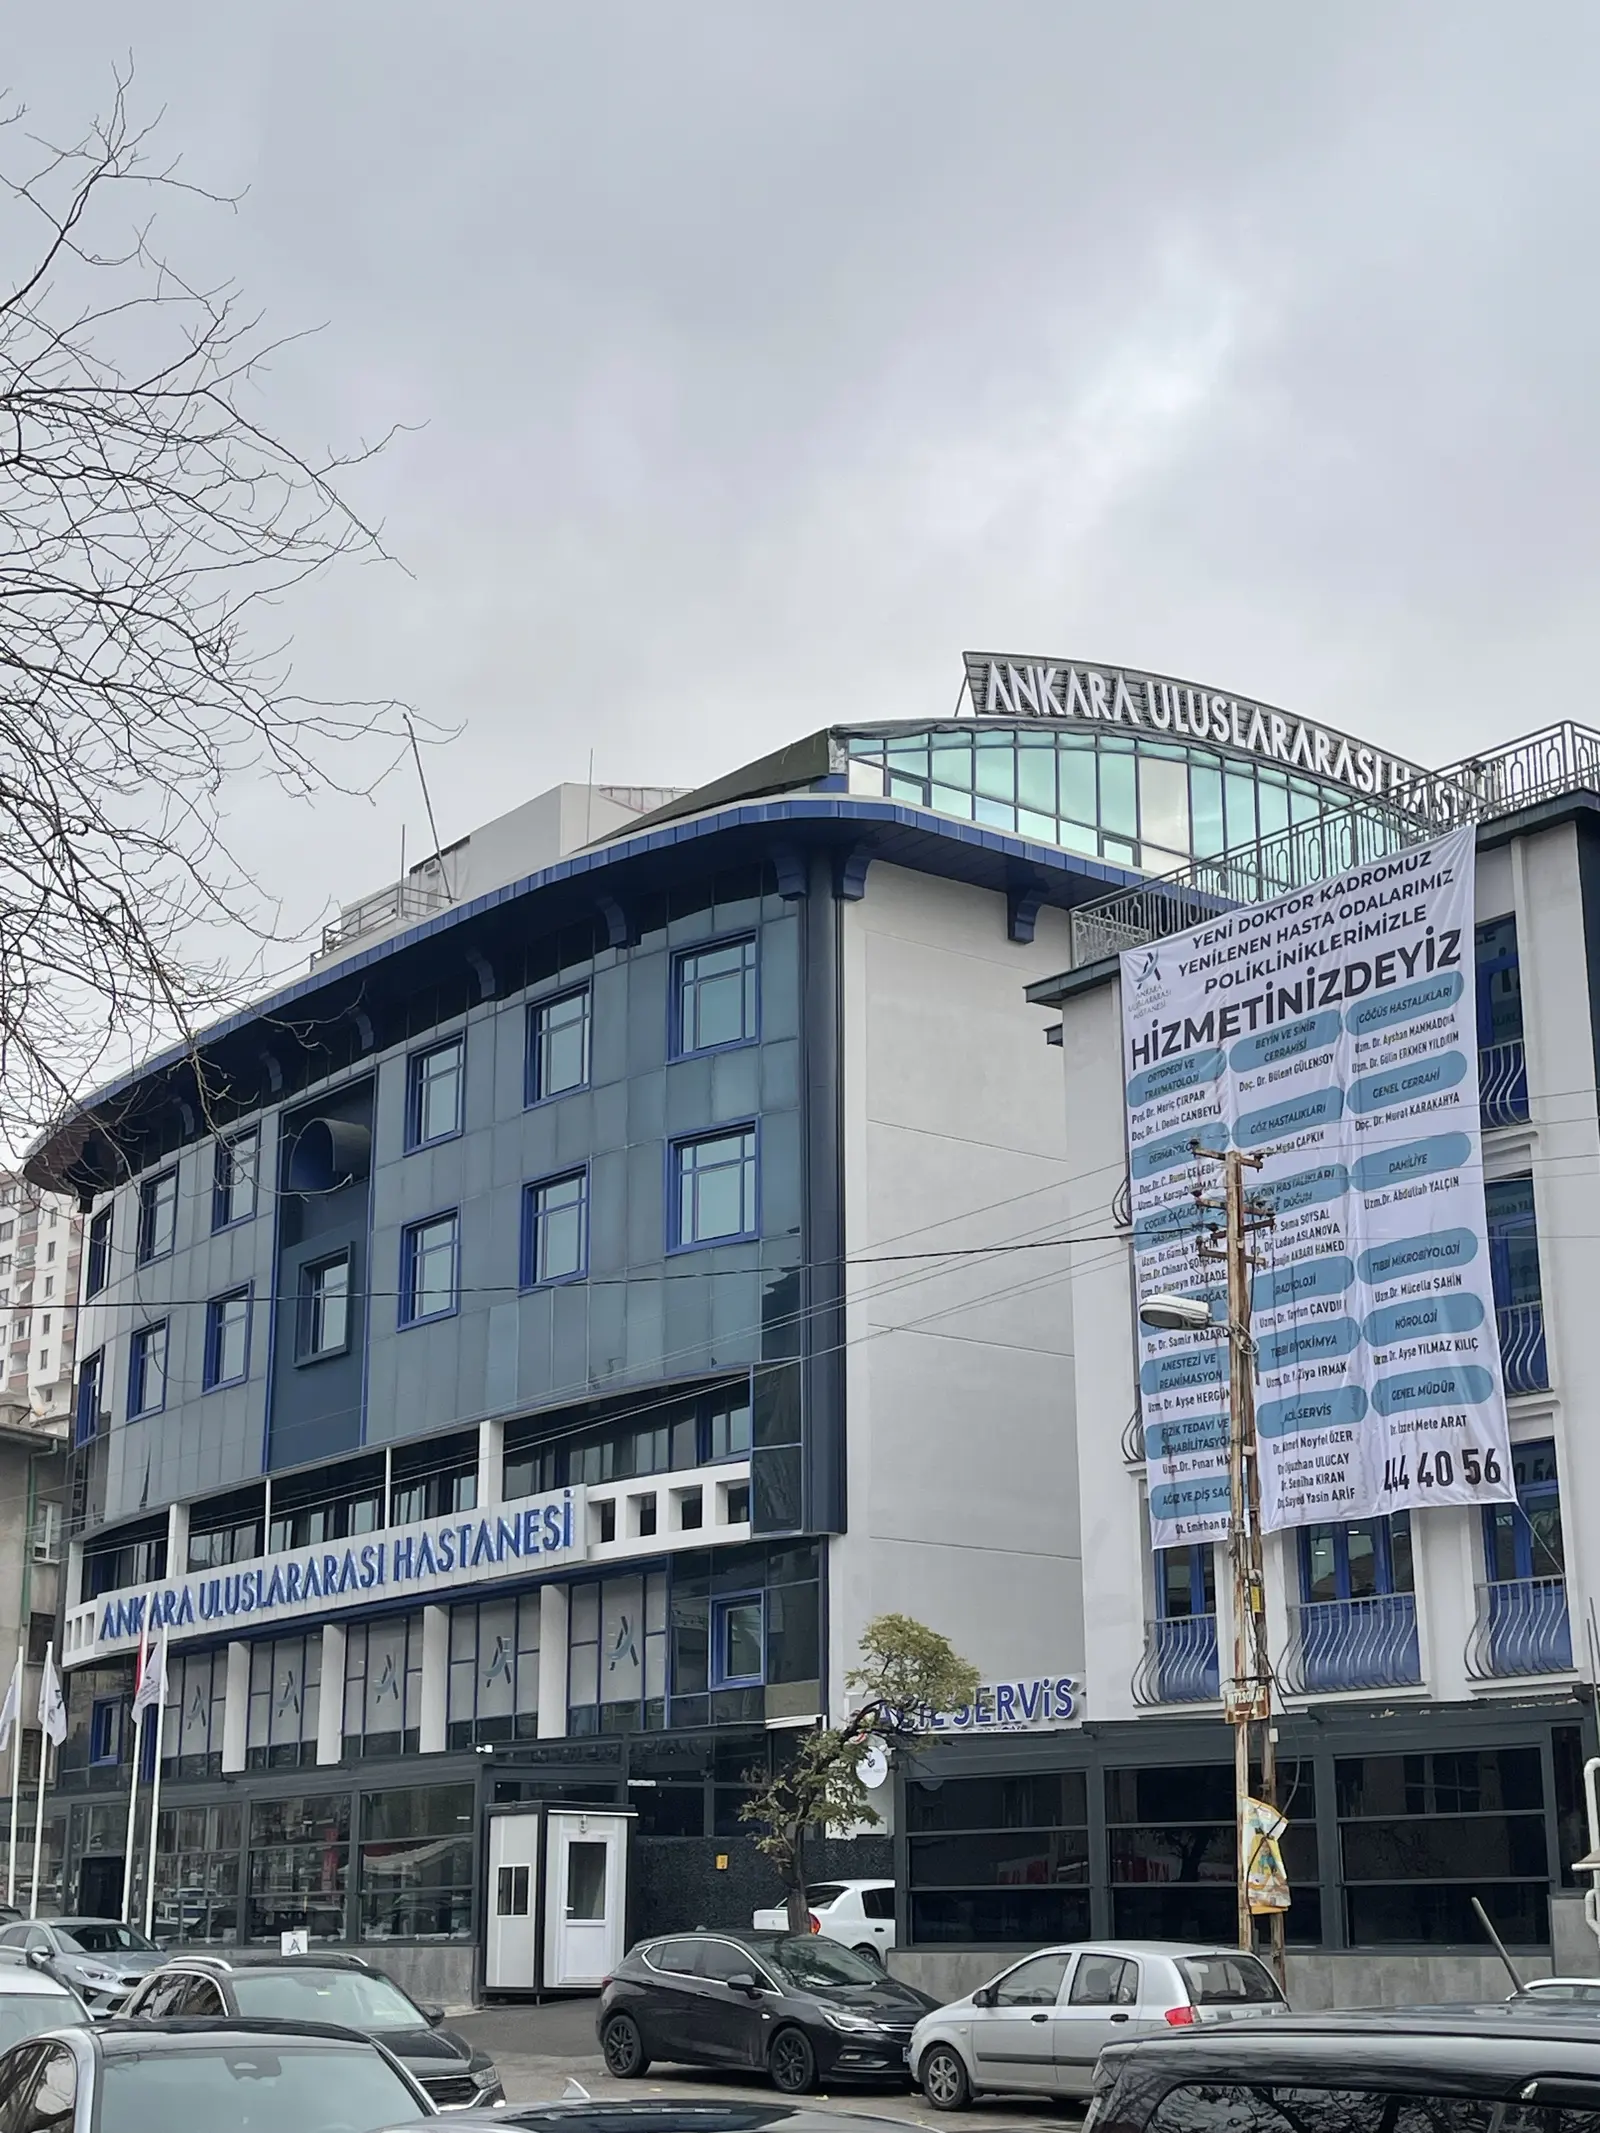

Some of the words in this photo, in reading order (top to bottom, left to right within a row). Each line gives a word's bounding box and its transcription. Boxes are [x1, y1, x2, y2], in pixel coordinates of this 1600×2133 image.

[987, 661, 1140, 724] ANKARA
[1147, 680, 1388, 795] ULUSLARARASI
[1192, 920, 1232, 949] YENİ
[1239, 893, 1314, 934] DOKTOR
[1320, 850, 1432, 903] KADROMUZ
[1179, 933, 1271, 977] YENİLENEN
[1276, 911, 1335, 944] HASTA
[1339, 869, 1454, 920] ODALARIMIZ
[1204, 904, 1427, 995] POLİKLİNİKLERİMİZLE
[1131, 926, 1461, 1071] HİZMETİNİZDEYİZ
[1389, 985, 1453, 1014] HASTALIKLARI
[1280, 1028, 1292, 1041] VE
[1400, 1068, 1441, 1091] CERRAHİ
[1373, 1114, 1385, 1127] Dr.
[1417, 1338, 1453, 1355] YILMAZ
[1454, 1337, 1479, 1353] KILIÇ
[1161, 1351, 1201, 1372] ANESTEZİ
[1203, 1353, 1217, 1365] VE
[1160, 1370, 1223, 1389] REANİMASYON
[1391, 1386, 1416, 1401] GENEL
[1417, 1380, 1456, 1397] MÜDÜR
[1297, 1402, 1332, 1419] SERVİS
[1216, 1417, 1230, 1429] VE
[1440, 1414, 1468, 1429] ARAT
[1329, 1430, 1354, 1445] ÖZER
[1383, 1454, 1410, 1494] 444
[1417, 1450, 1454, 1488] 40
[1461, 1448, 1502, 1486] 56
[1181, 1491, 1193, 1502] VE
[1331, 1485, 1357, 1501] ARİF
[101, 1583, 196, 1641] ANKARA
[199, 1543, 388, 1621] ULUSLARARASI
[393, 1489, 577, 1582] HASTANESİ
